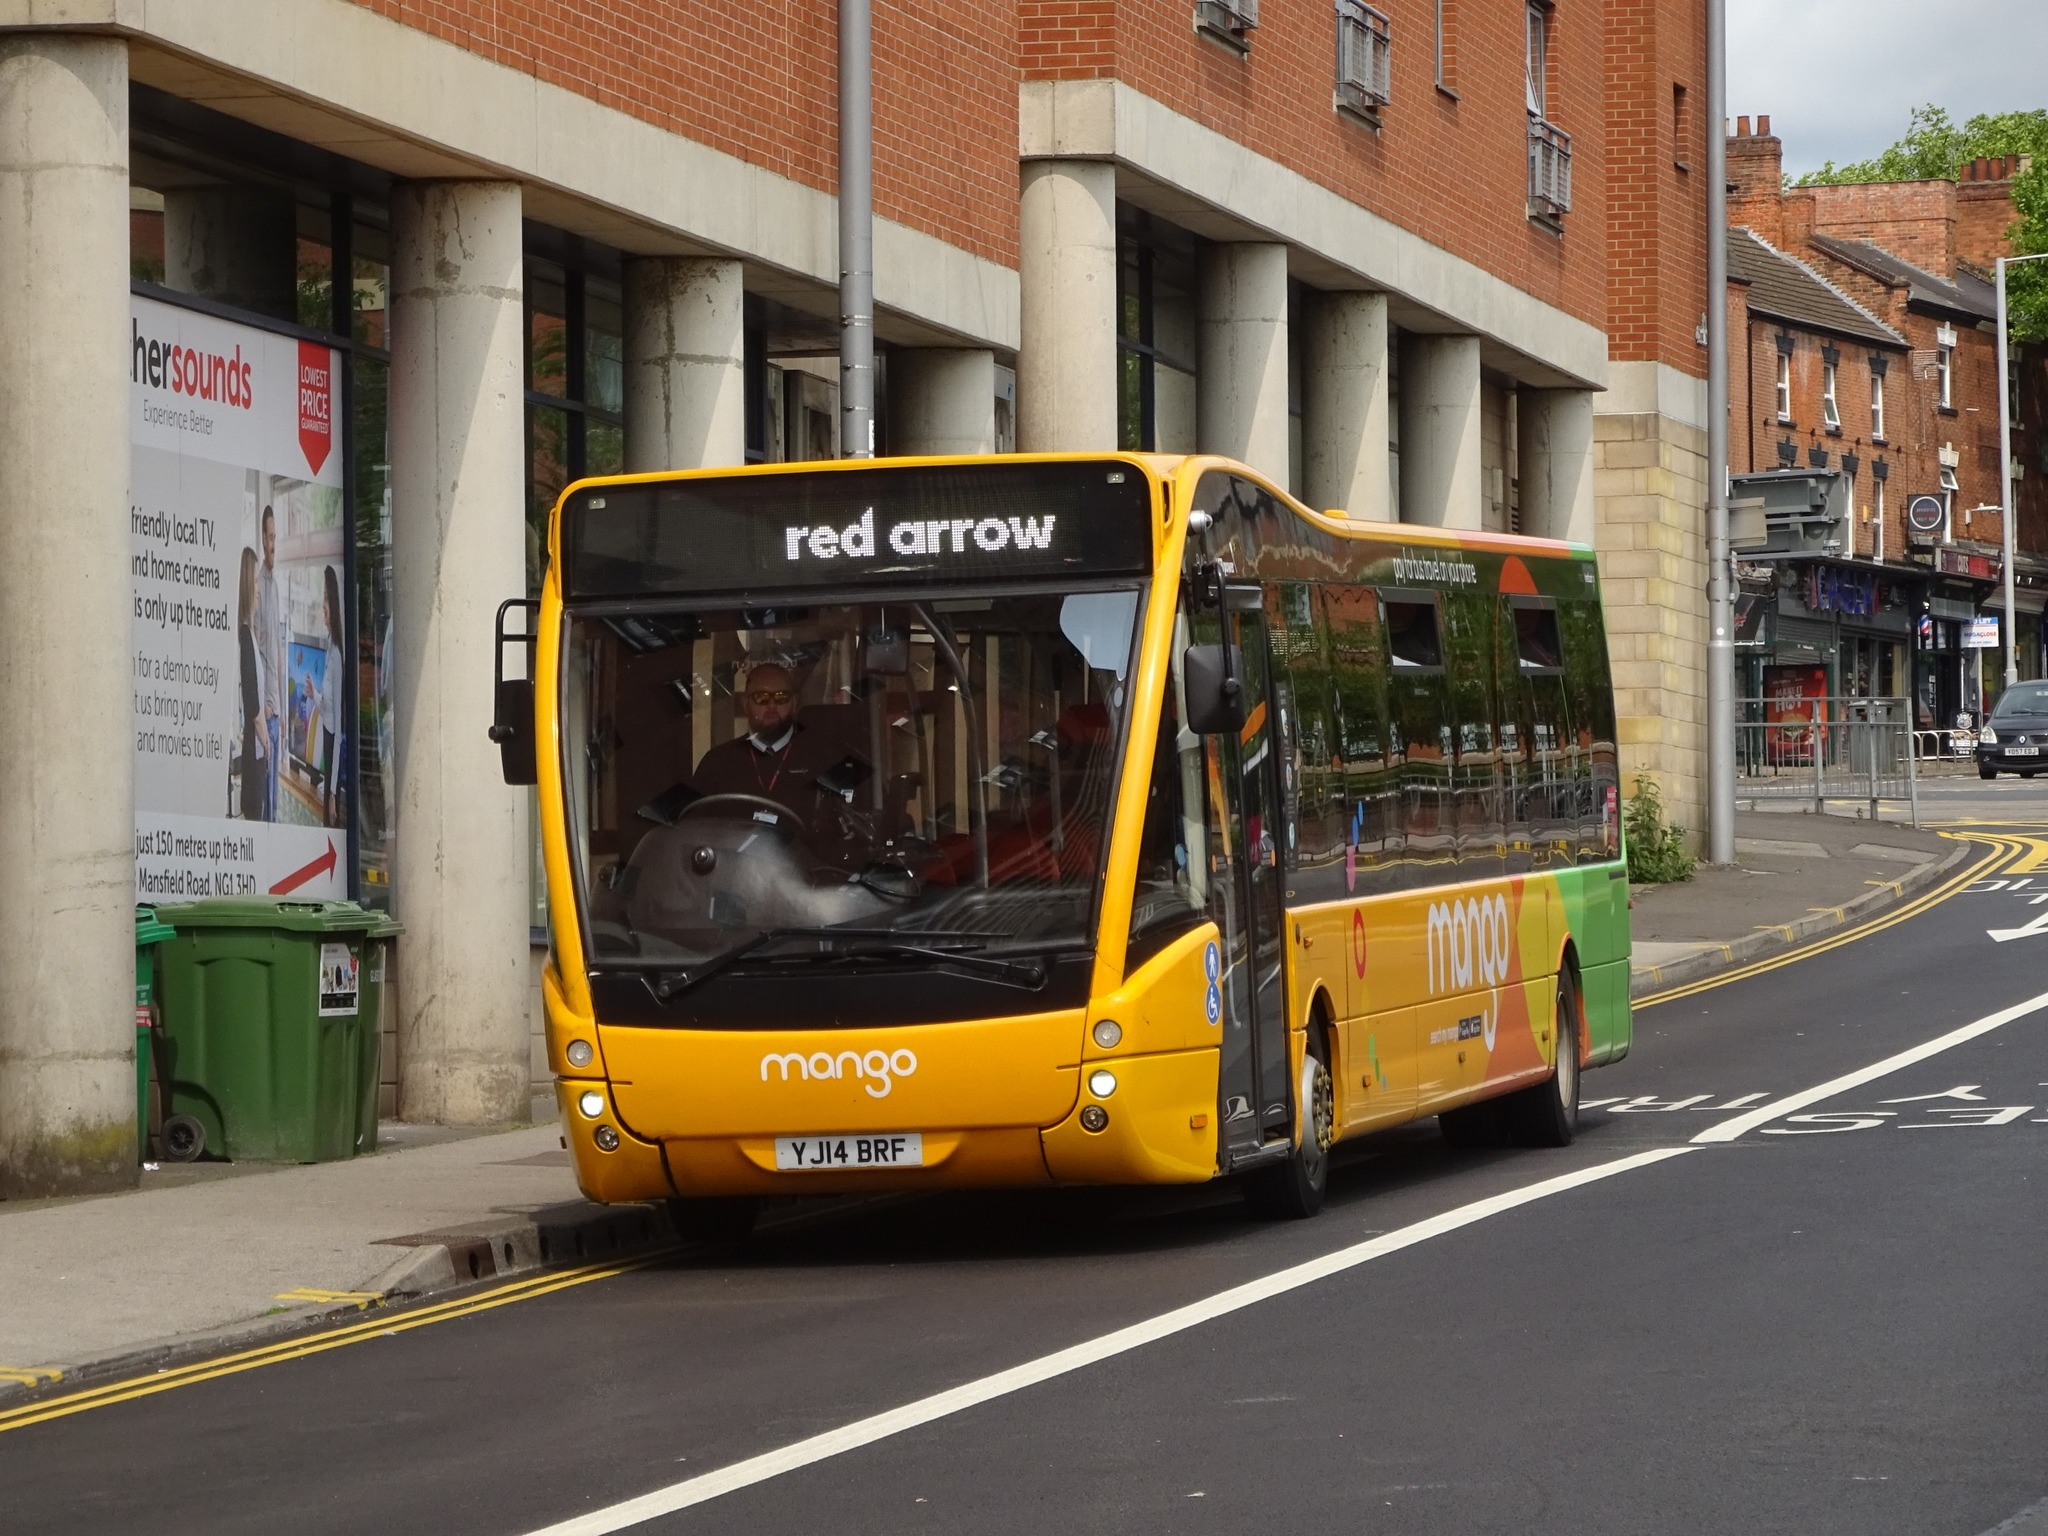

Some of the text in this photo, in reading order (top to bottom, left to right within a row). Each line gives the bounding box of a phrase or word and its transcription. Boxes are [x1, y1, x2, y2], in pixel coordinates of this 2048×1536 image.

[130, 317, 252, 410] hersounds
[300, 365, 327, 388] LOWEST
[143, 399, 214, 435] Experience Better
[301, 388, 328, 420] PRICE
[131, 505, 216, 552] friendly local TV,
[785, 506, 1056, 560] red arrow
[150, 550, 181, 583] home
[183, 557, 220, 590] cinema
[134, 588, 230, 632] is only up the road.
[138, 650, 152, 678] for
[154, 659, 160, 680] a
[162, 654, 191, 684] demo
[193, 659, 219, 694] today
[140, 695, 152, 716] us
[154, 689, 180, 726] bring
[181, 700, 203, 727] your
[137, 726, 222, 760] and movies to life!
[135, 828, 254, 866] just 150 metres up the hill
[138, 867, 185, 894] Mansfield
[186, 870, 213, 897] Road,
[214, 872, 234, 896] NG1
[1427, 893, 1509, 1052] mango
[760, 1048, 918, 1099] mango
[791, 1138, 906, 1165] YJ14 BRF
